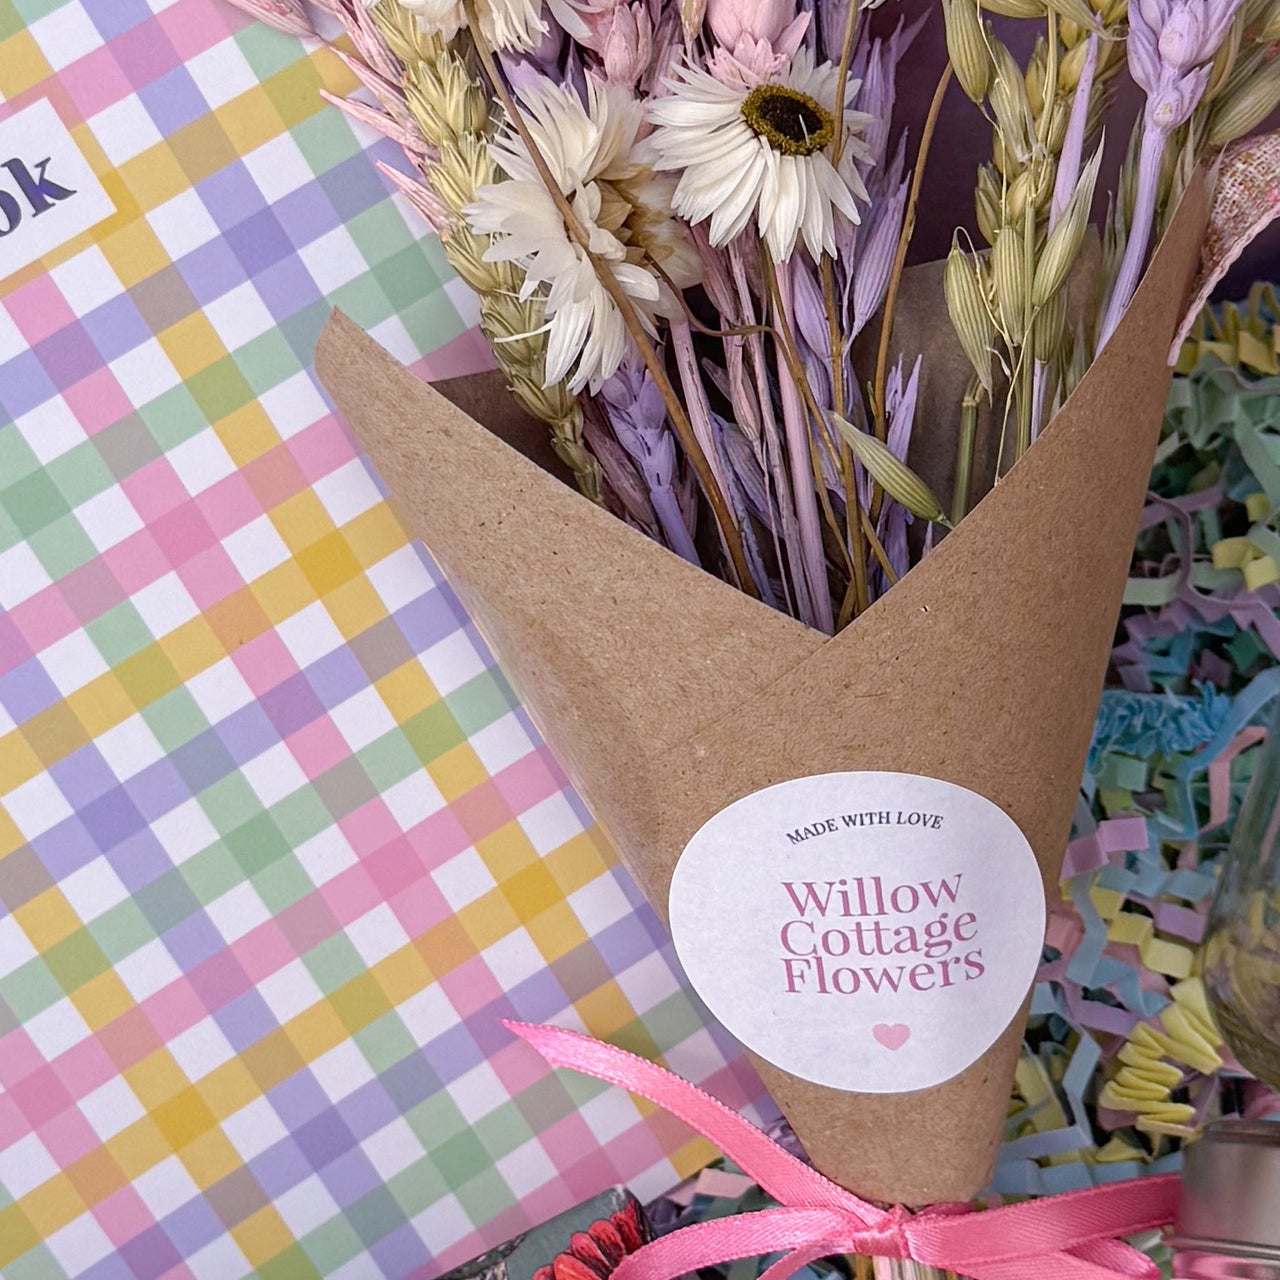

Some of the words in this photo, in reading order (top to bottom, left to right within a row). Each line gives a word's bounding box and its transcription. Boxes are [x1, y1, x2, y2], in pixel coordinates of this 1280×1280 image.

[786, 818, 839, 845] MADE
[841, 811, 891, 829] WITH
[896, 811, 944, 830] LOVE
[781, 873, 963, 917] Willow
[780, 911, 978, 958] Cottage
[780, 948, 986, 995] Flowers
